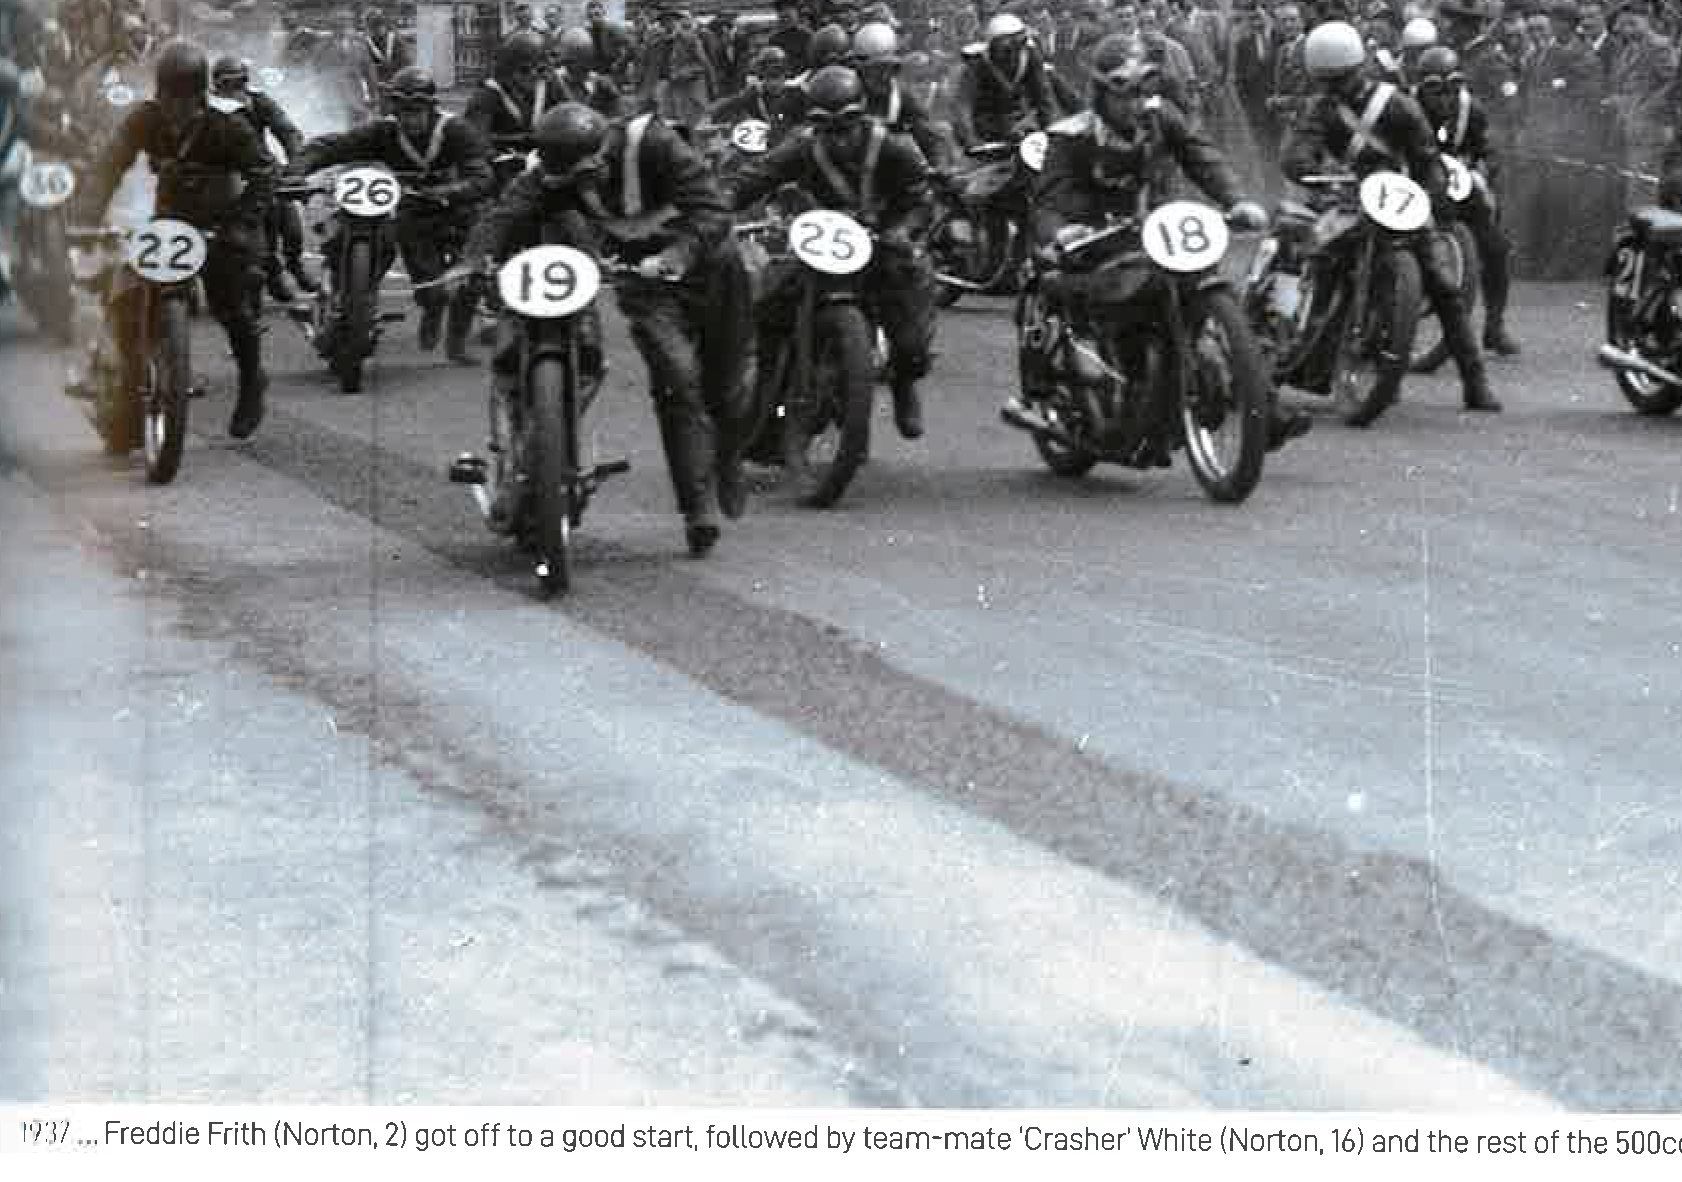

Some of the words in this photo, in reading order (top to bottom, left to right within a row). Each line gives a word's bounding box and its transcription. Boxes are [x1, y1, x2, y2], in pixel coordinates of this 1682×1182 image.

[342, 177, 395, 207] 26
[1377, 180, 1416, 215] 17
[137, 232, 194, 270] 22
[797, 221, 857, 261] 25
[1157, 215, 1212, 257] 18
[520, 260, 579, 303] 19
[1614, 247, 1646, 300] 21
